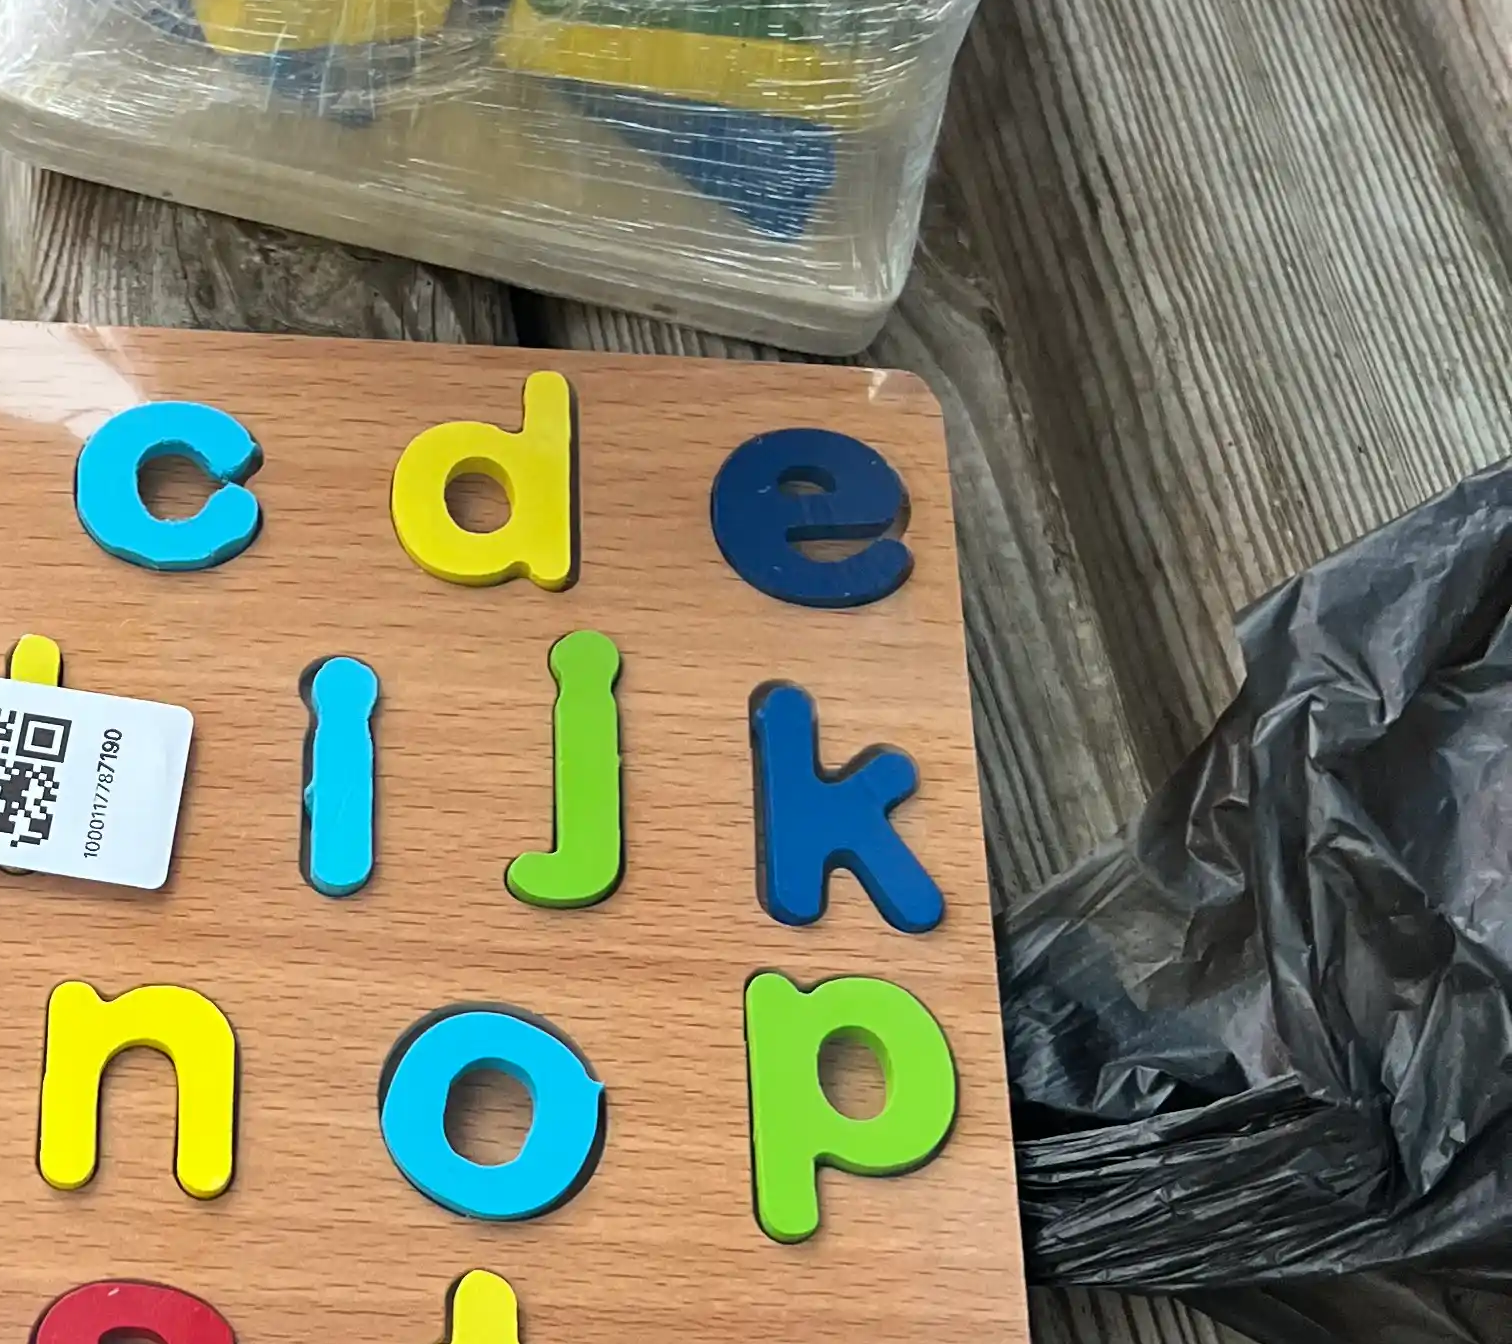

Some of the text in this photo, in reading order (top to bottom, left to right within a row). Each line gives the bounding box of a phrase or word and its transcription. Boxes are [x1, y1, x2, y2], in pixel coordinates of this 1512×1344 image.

[75, 401, 261, 569] c
[391, 370, 578, 589] d
[711, 428, 914, 604] e
[83, 728, 123, 859] 1000117787190
[506, 631, 624, 908] j
[752, 681, 946, 931] k
[38, 981, 237, 1198] n
[380, 1006, 606, 1218] o
[744, 970, 958, 1242] p
